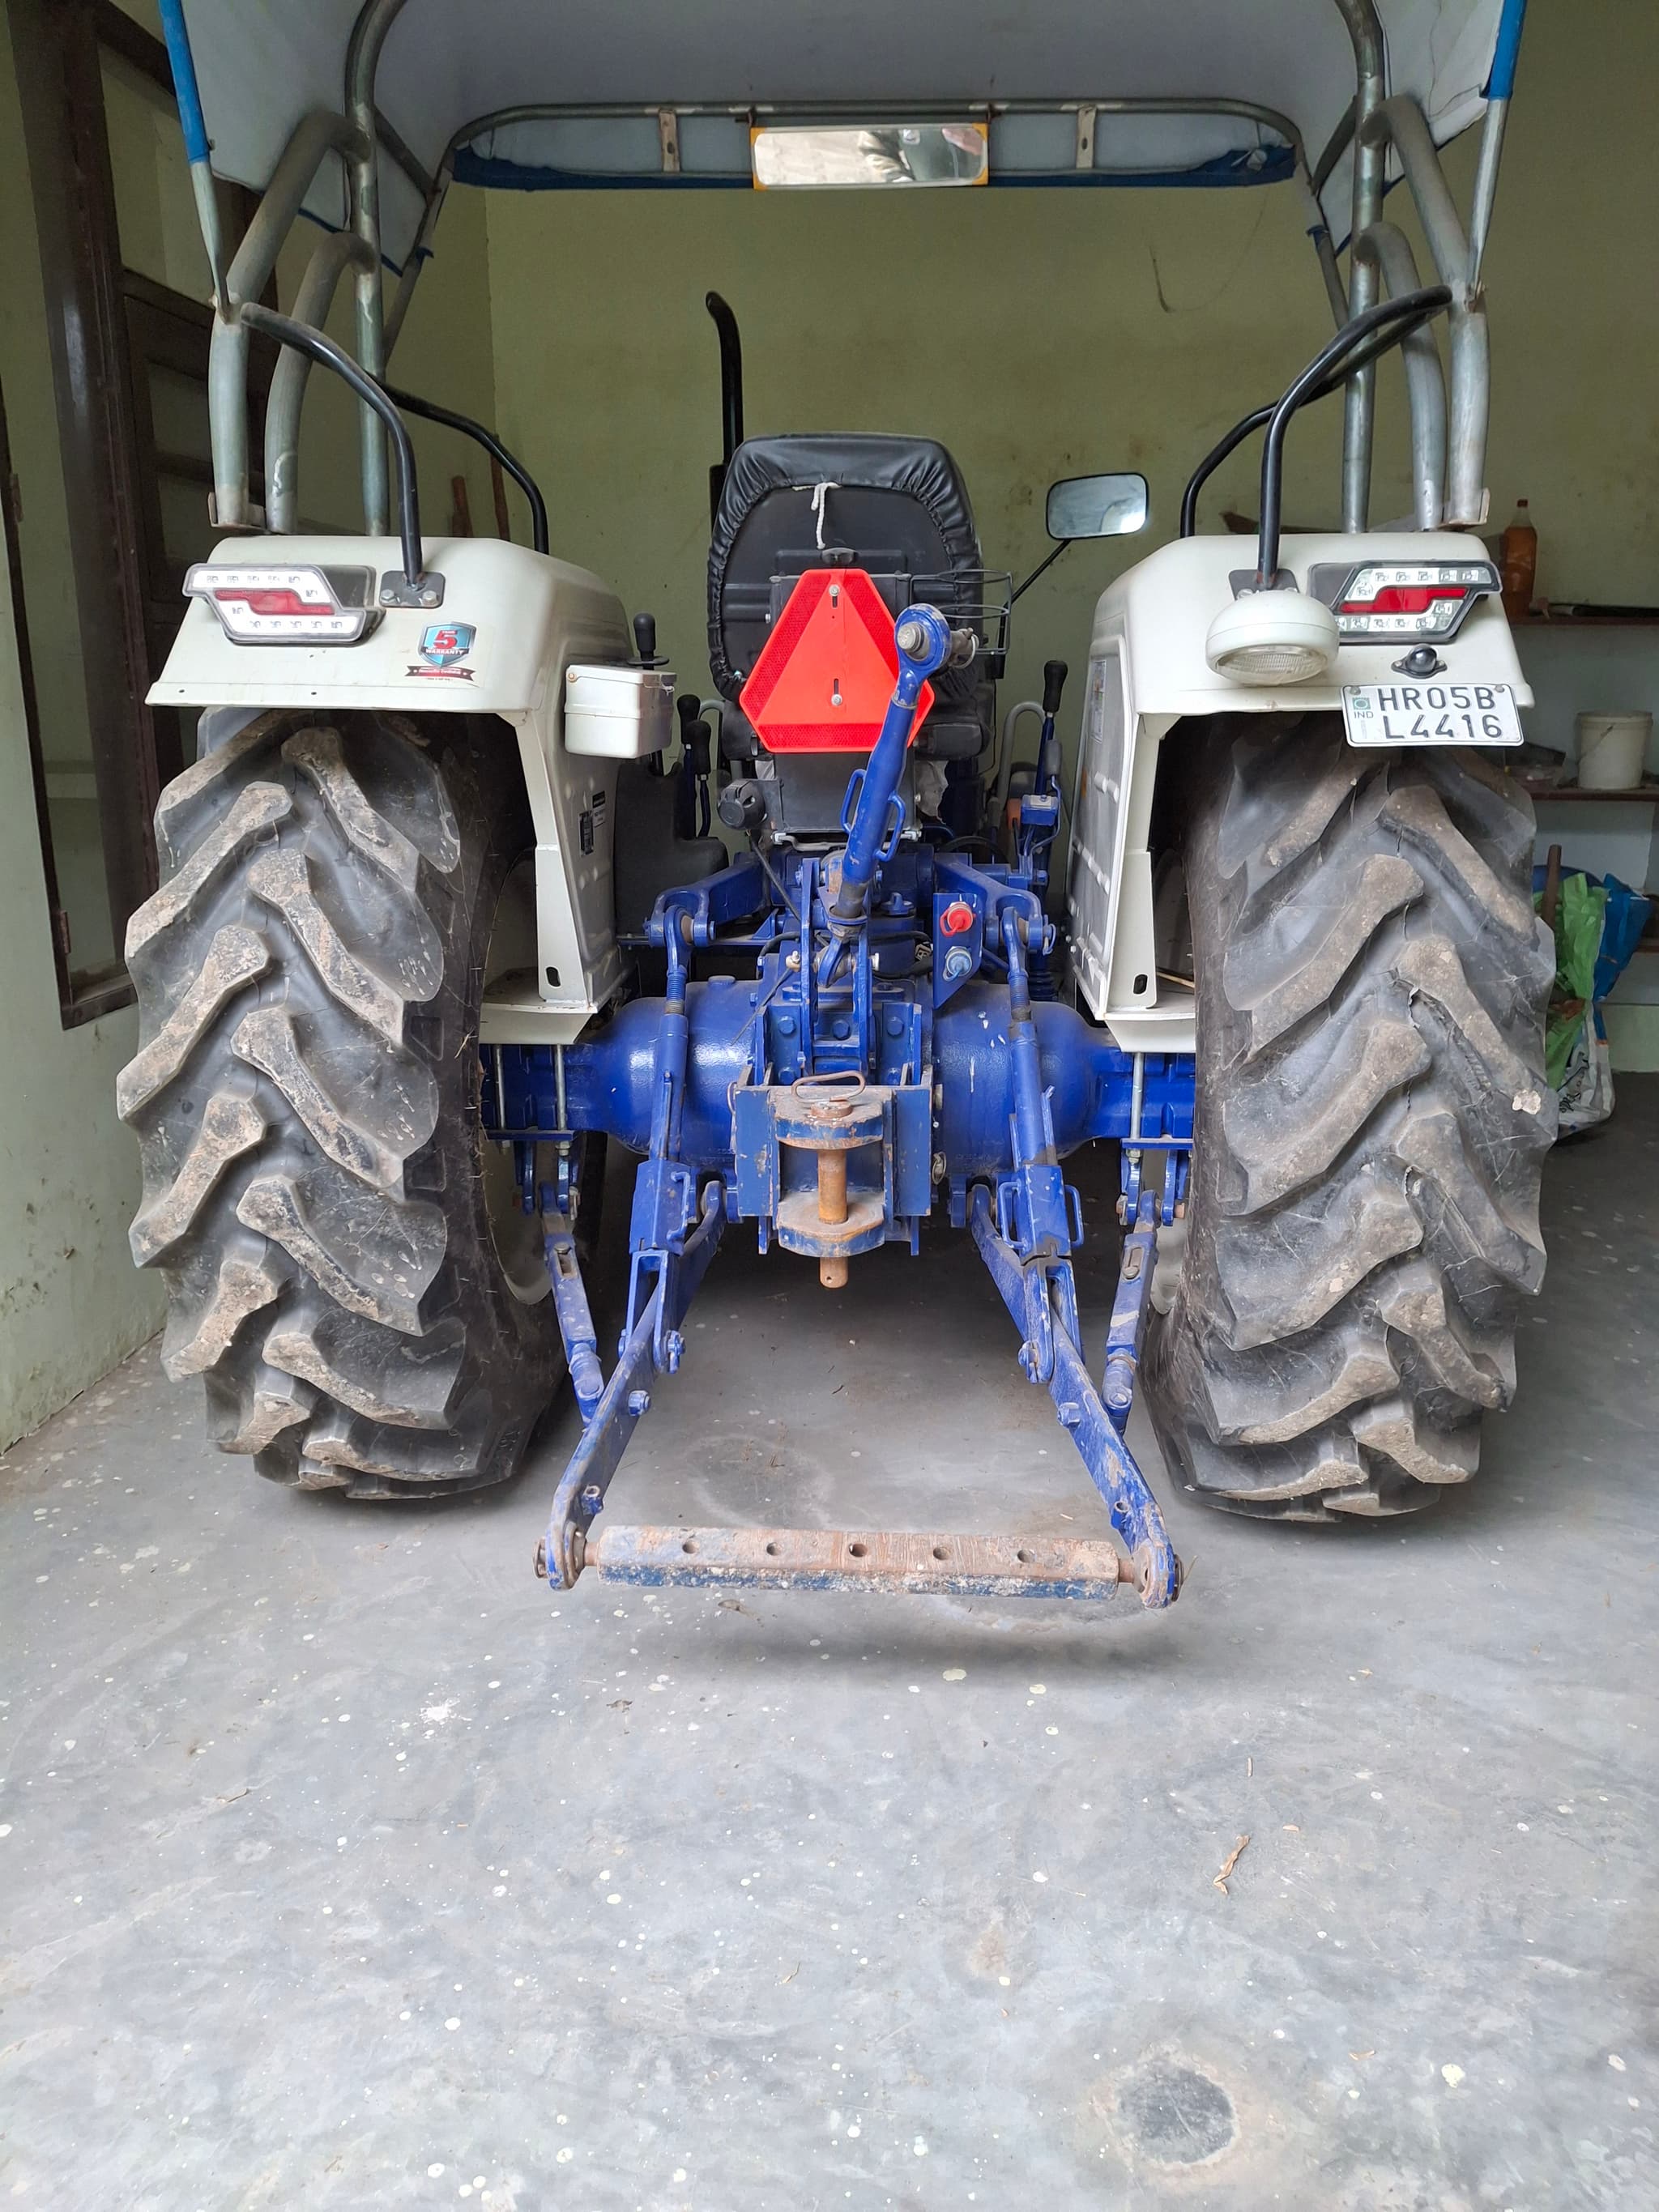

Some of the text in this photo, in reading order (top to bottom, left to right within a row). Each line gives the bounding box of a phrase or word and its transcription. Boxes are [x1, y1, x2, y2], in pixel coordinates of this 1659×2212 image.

[433, 629, 458, 650] 5
[1377, 687, 1496, 711] HR05B
[1383, 714, 1503, 739] L4416
